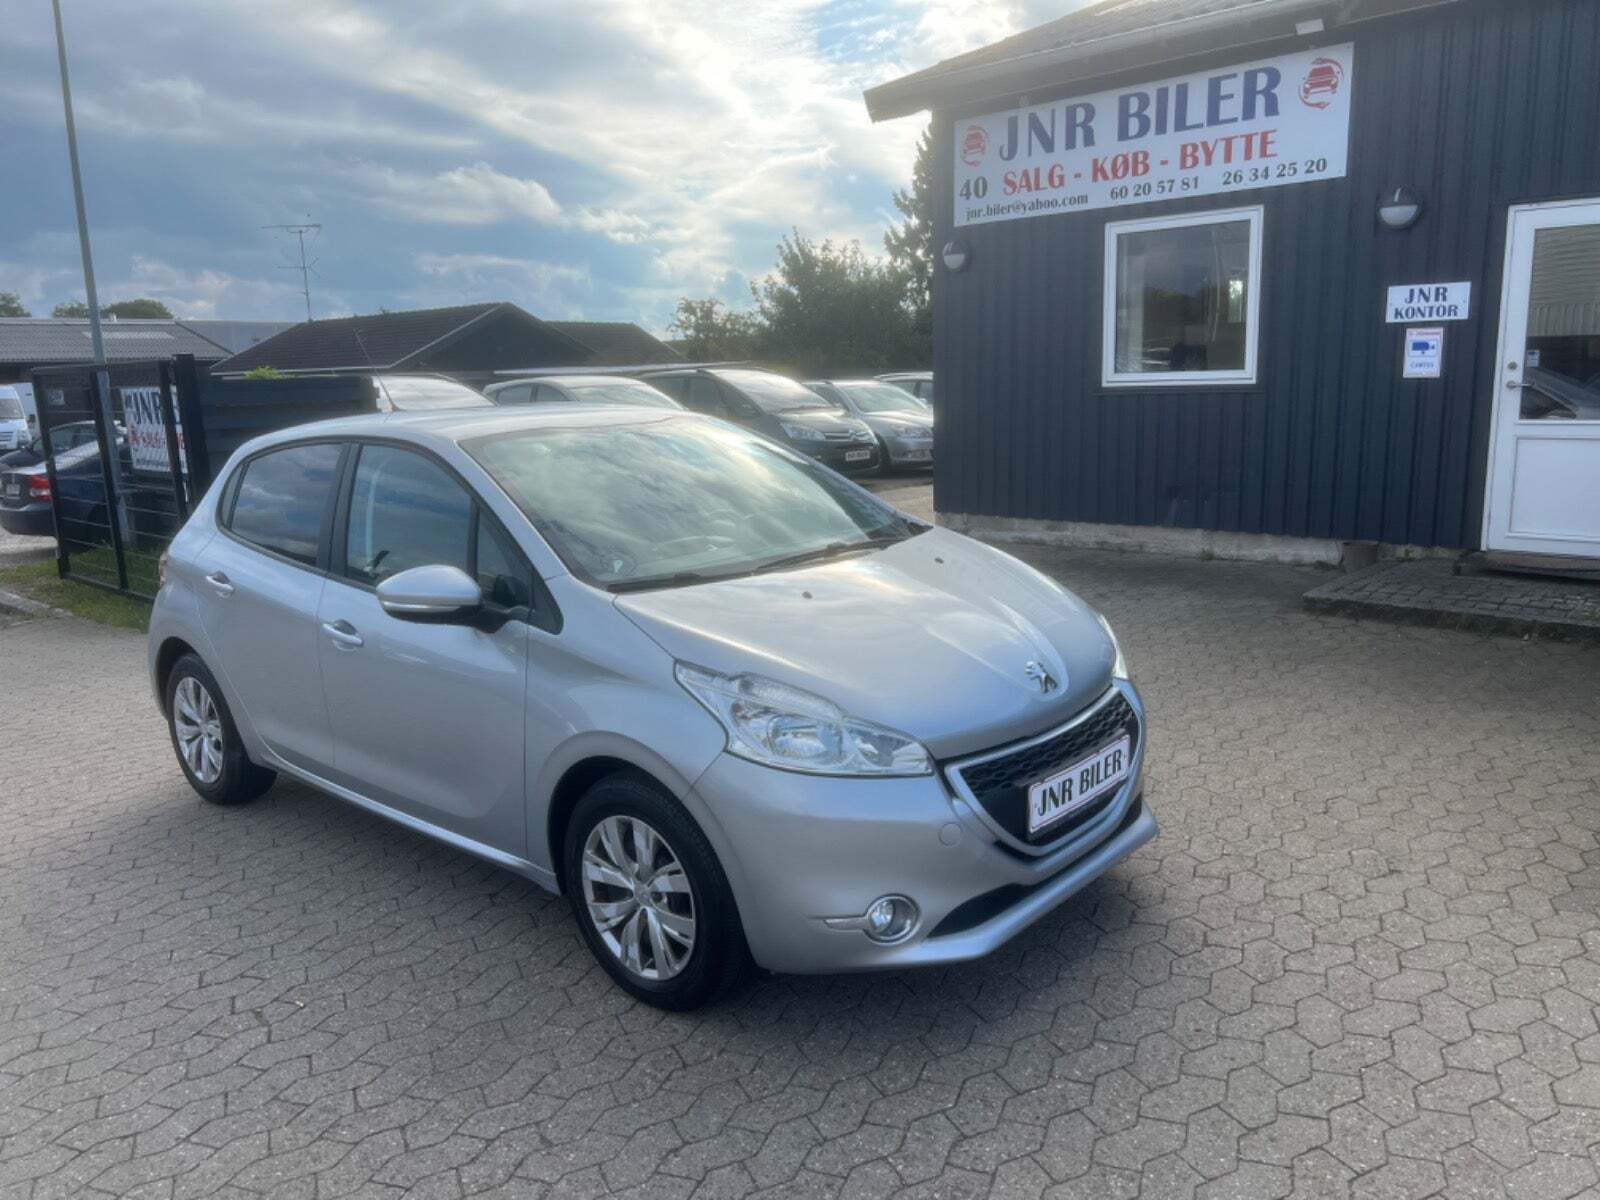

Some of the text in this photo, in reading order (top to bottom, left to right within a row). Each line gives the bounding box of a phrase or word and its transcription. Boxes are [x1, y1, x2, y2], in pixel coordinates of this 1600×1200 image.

[999, 66, 1281, 162] JNR BILER
[1003, 164, 1066, 197] SALG
[1091, 149, 1150, 183] KØB
[1179, 129, 1278, 170] BYTTE
[1222, 158, 1328, 186] 26 34 25 20
[959, 176, 988, 201] 40
[1109, 176, 1199, 201] 60 20 57 81
[1404, 286, 1448, 304] JNR
[1394, 304, 1459, 320] KONTOR
[1037, 749, 1122, 817] JNR BILER
